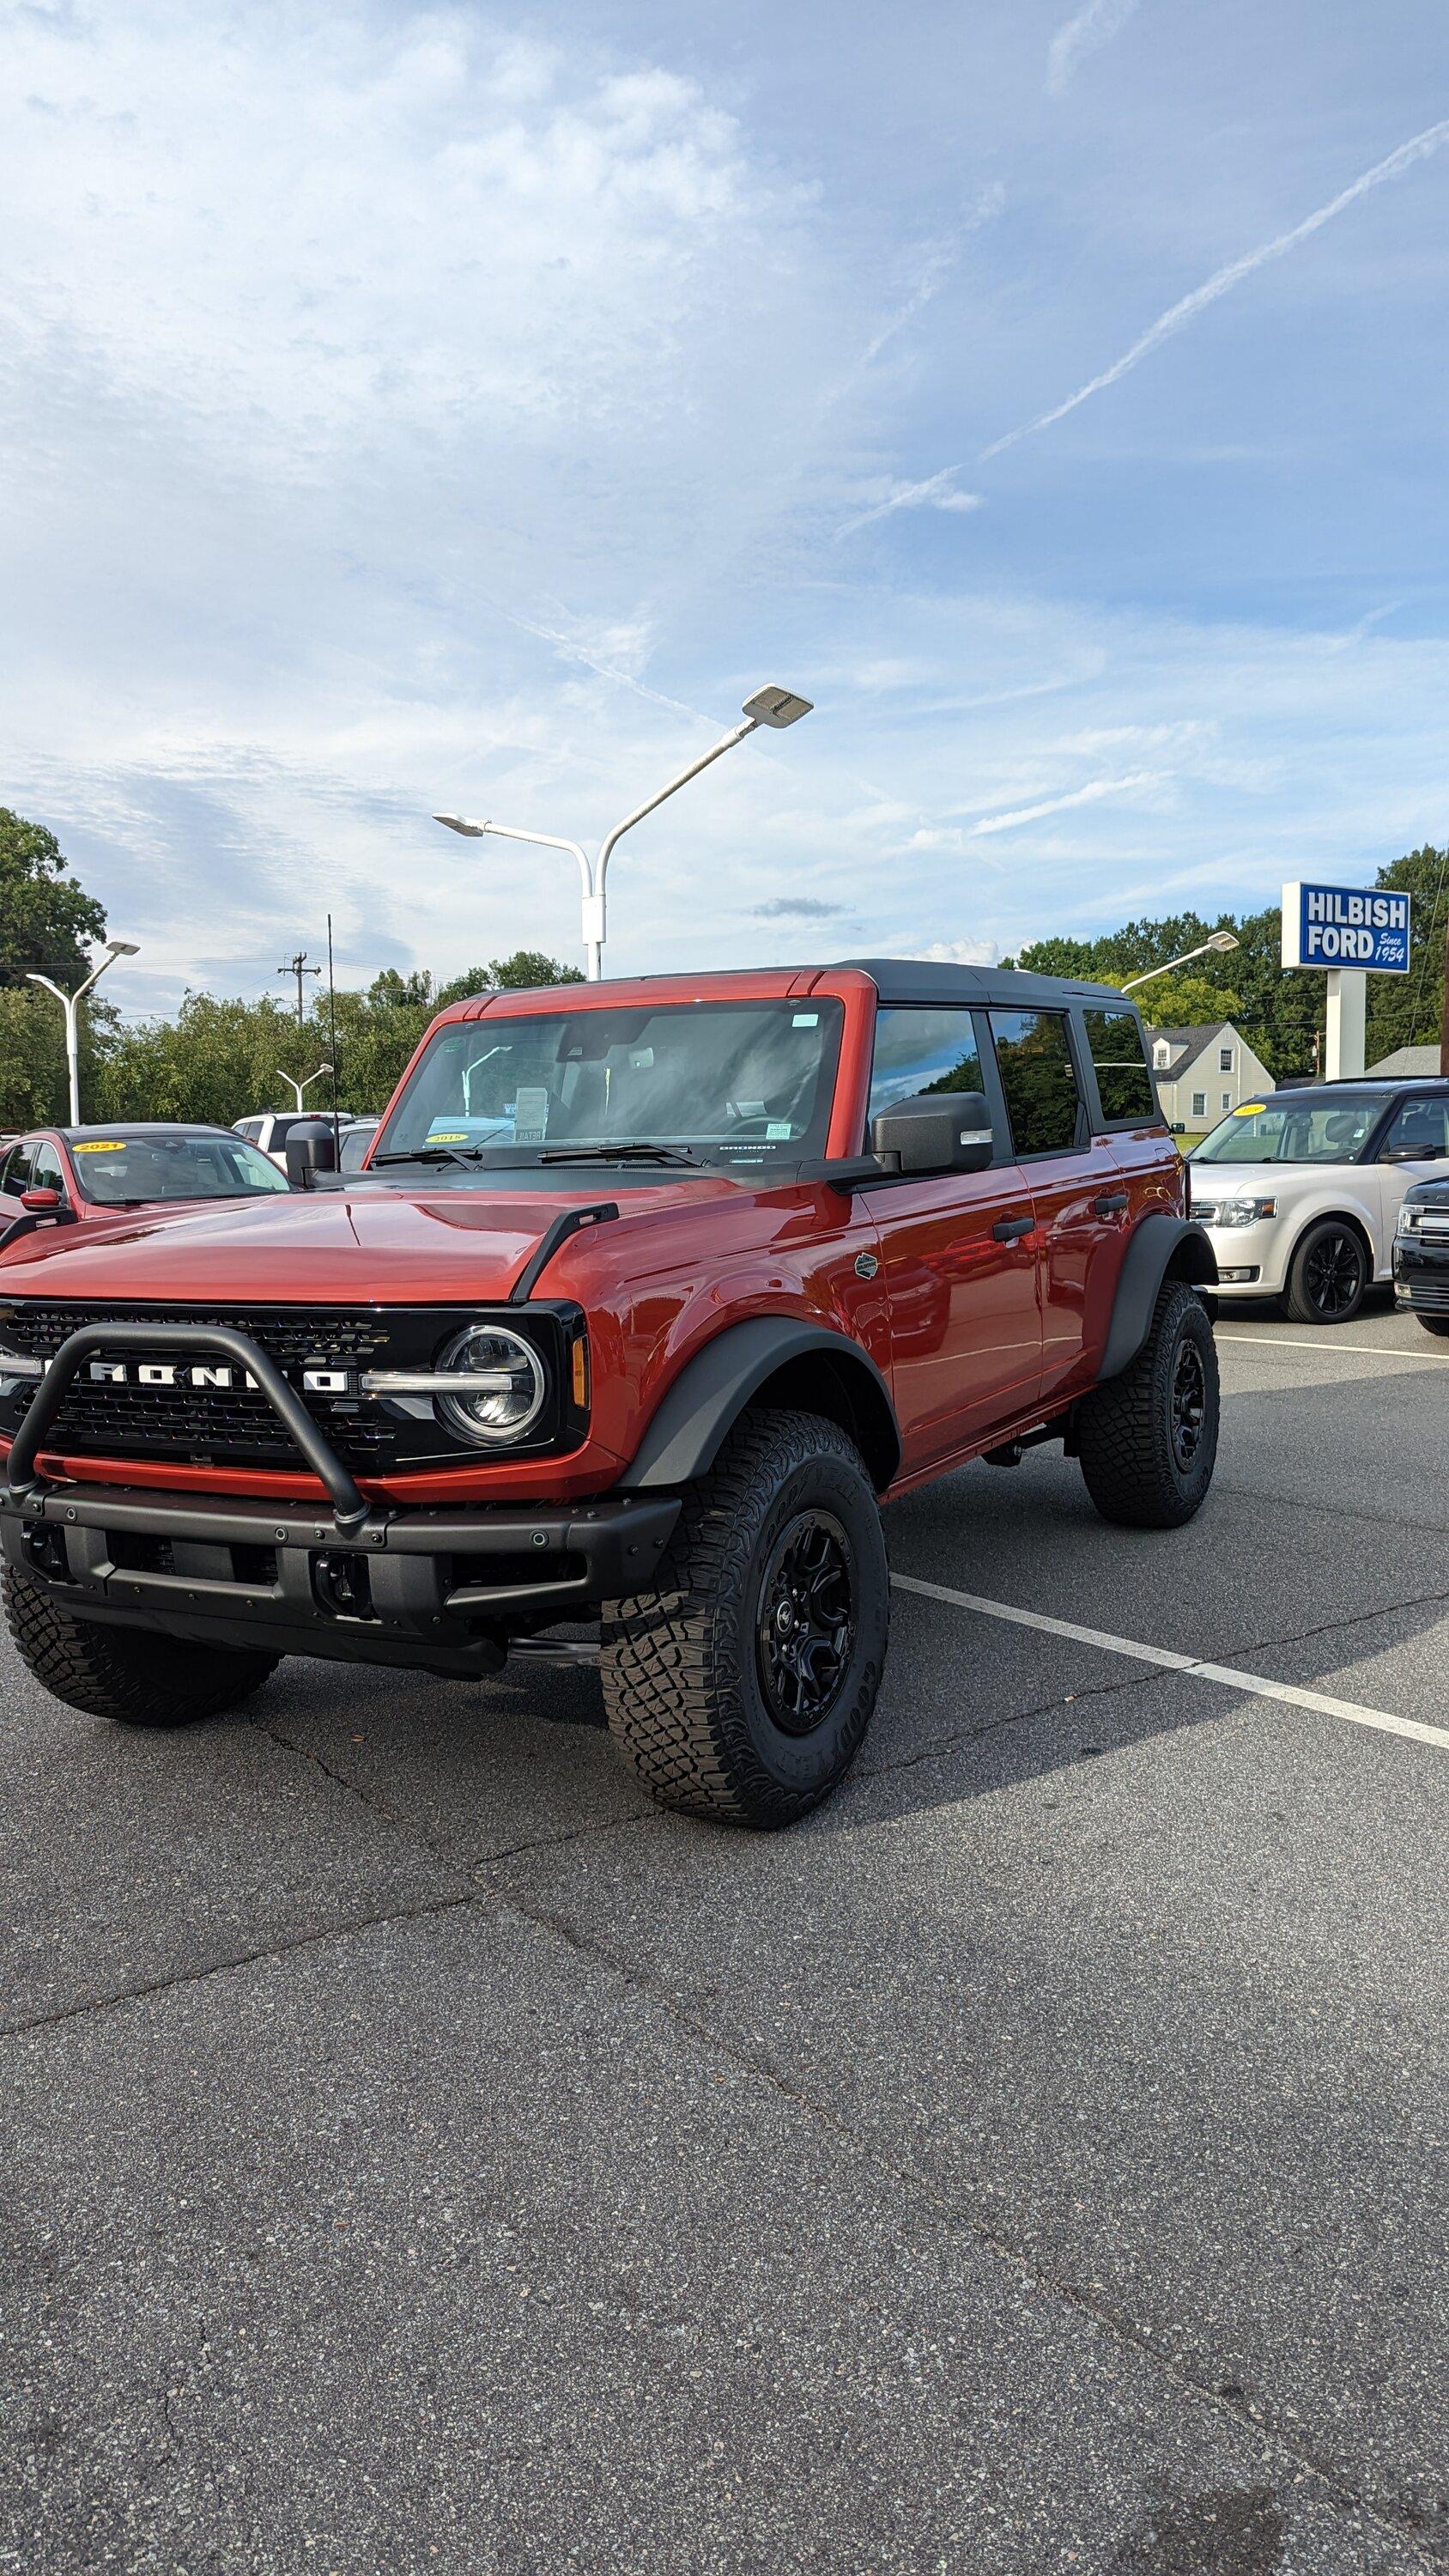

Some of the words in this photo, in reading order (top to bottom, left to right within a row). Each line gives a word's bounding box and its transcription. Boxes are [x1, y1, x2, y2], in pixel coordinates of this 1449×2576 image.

[1308, 892, 1405, 928] HILBISH
[1307, 925, 1374, 959] FORD
[1379, 933, 1403, 945] Since
[1374, 945, 1405, 963] 1954
